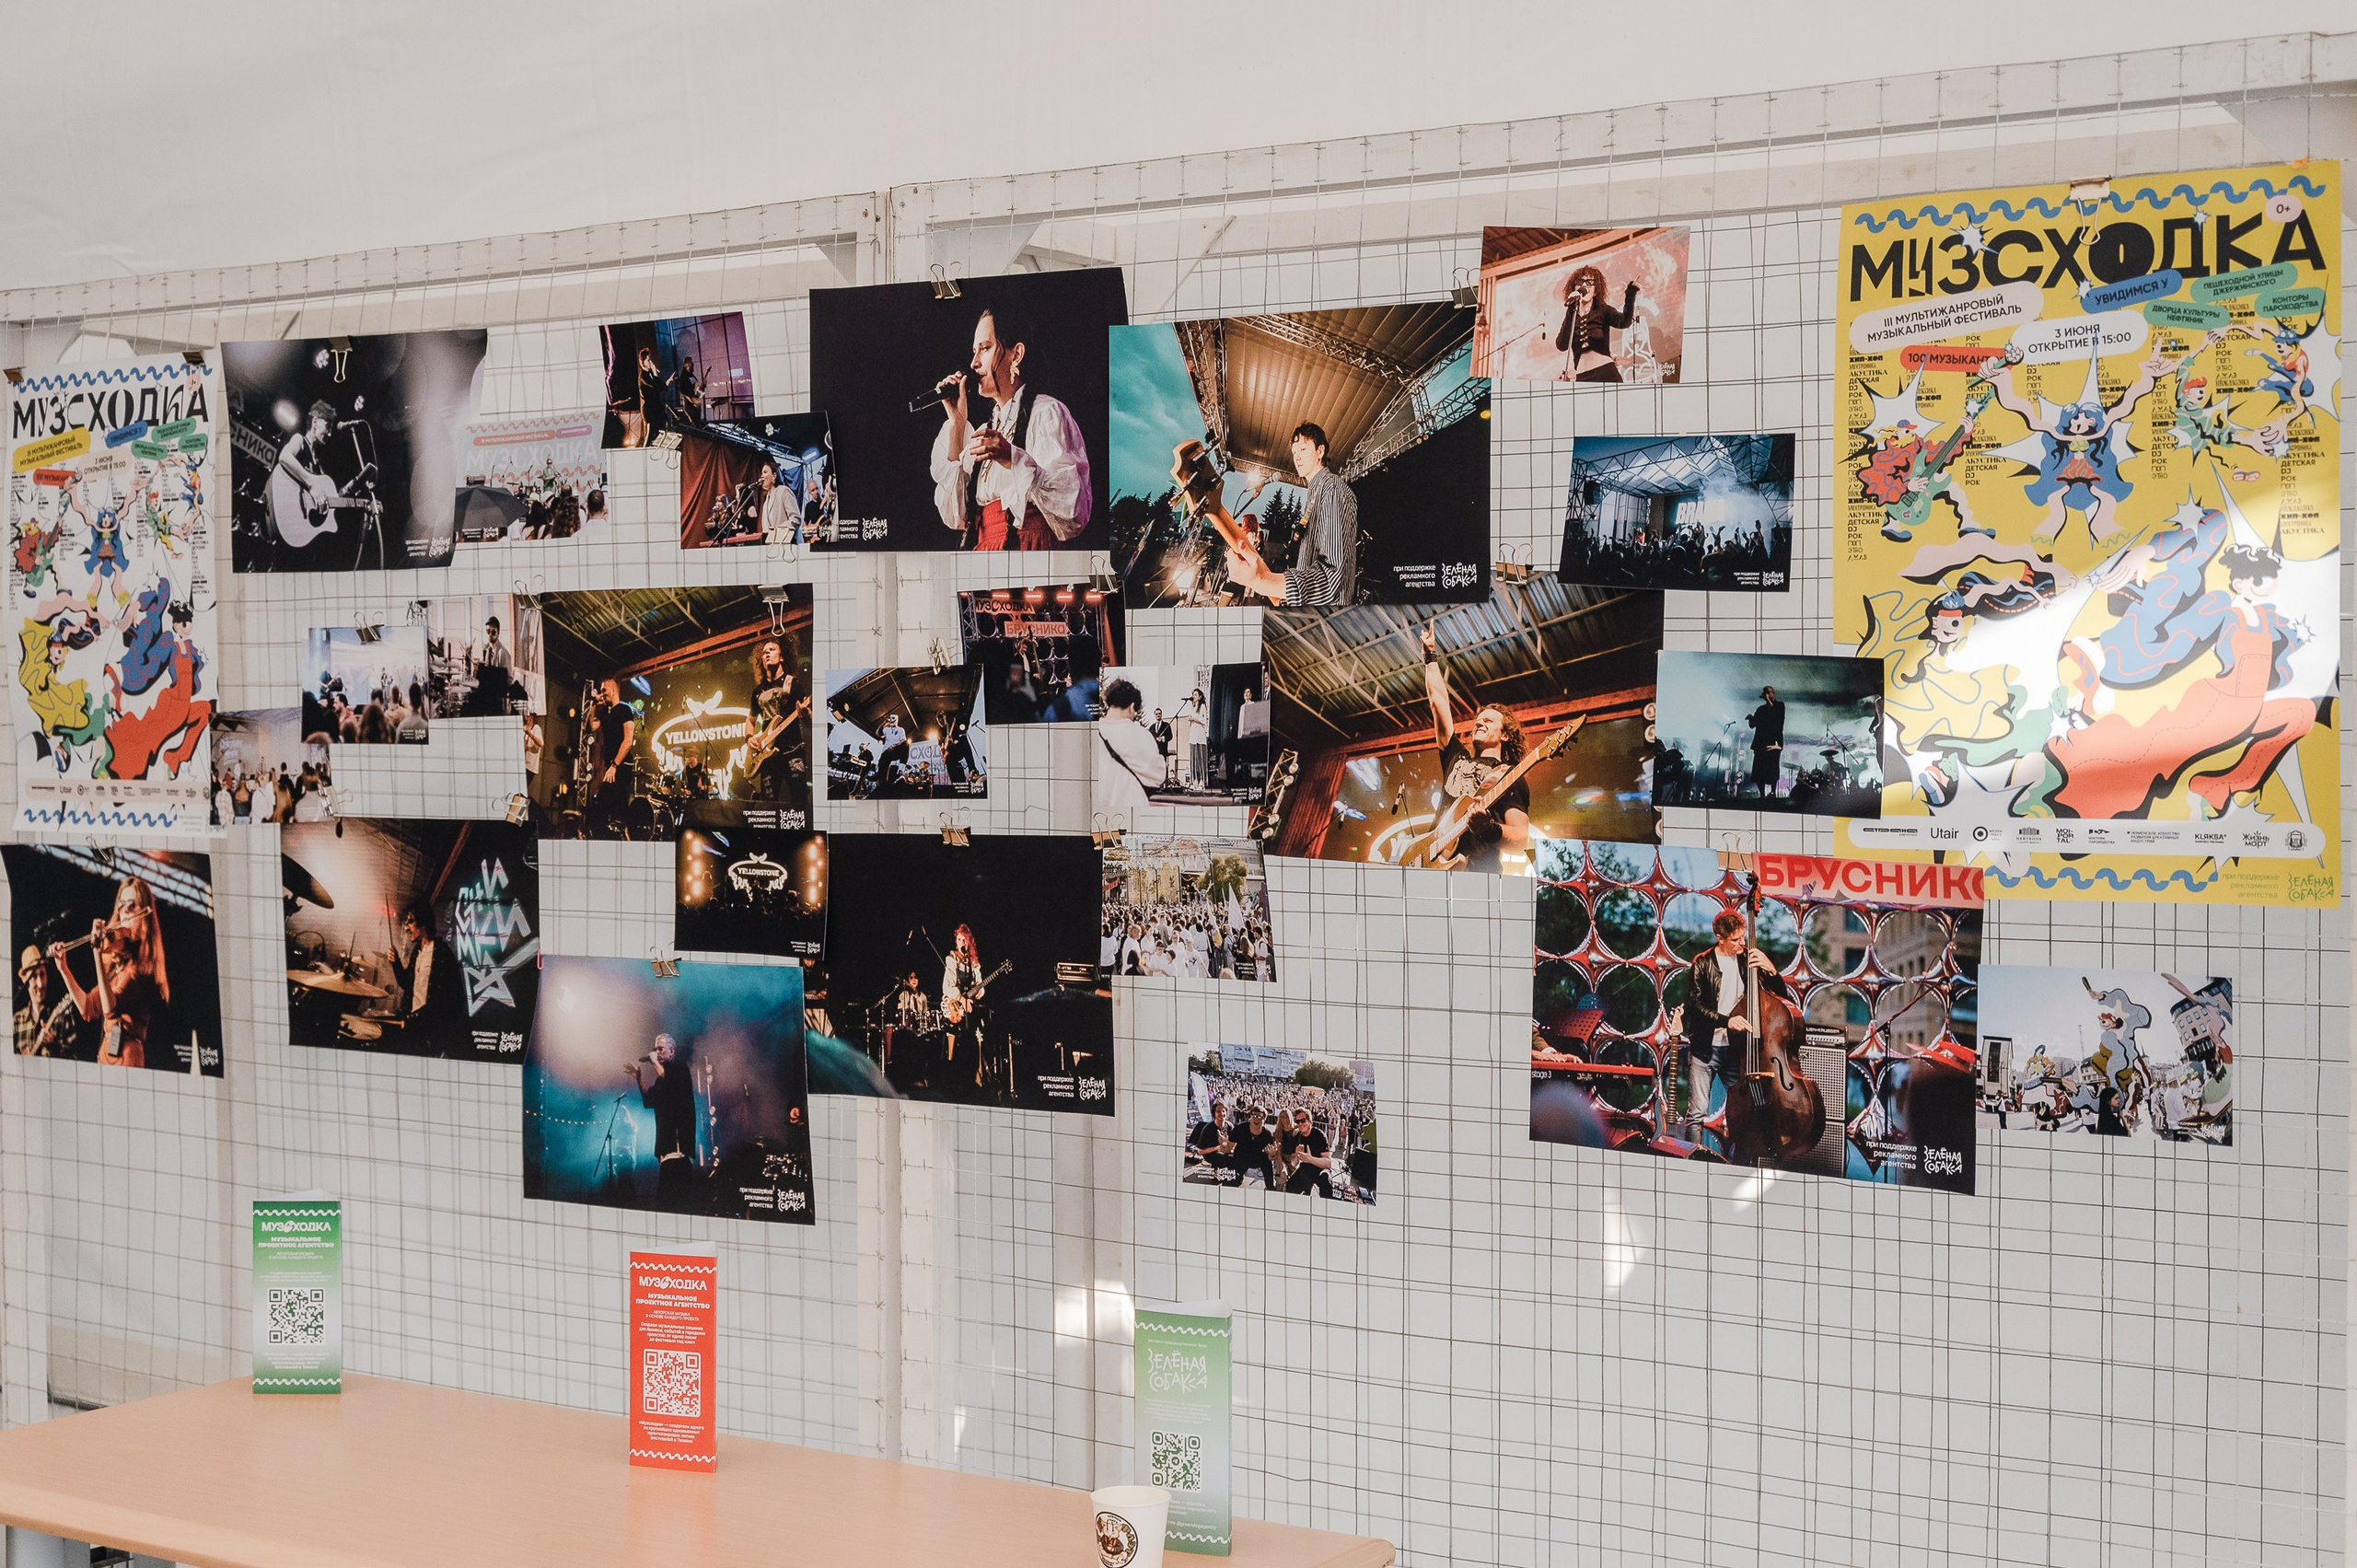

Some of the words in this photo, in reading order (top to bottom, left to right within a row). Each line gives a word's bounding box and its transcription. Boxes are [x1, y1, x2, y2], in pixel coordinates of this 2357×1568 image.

[2275, 203, 2292, 215] 0+
[2203, 272, 2256, 290] ПЕШЕХОДНОЙ
[2257, 269, 2284, 281] УЛИЦЫ
[2095, 281, 2158, 306] УВИДИМСЯ
[2160, 278, 2168, 288] У
[2272, 294, 2309, 304] КОНТОРЫ
[1896, 293, 2004, 325] МУЛЬТИЖАНРОВЫЙ
[2152, 305, 2182, 314] ДВОРЦА
[2183, 308, 2220, 319] КУЛЬТУРЫ
[2263, 301, 2318, 313] ПАРОХОДСТВА
[1867, 316, 1951, 343] МУЗЫКАЛЬНЫЙ
[1954, 304, 2022, 325] ФЕСТИВАЛЬ
[2166, 315, 2204, 324] НЕФТЯНИК
[2055, 329, 2061, 338] 3
[2064, 324, 2100, 337] ИЮНЯ
[2028, 337, 2089, 354] ОТКРЫТИЕ
[2102, 331, 2131, 345] 15:00
[13, 384, 209, 439] МУЗСХОДКА
[862, 517, 887, 532] ЗЕЛЁНАЯ
[1442, 562, 1477, 578] ЗЕЛЁНАЯ
[665, 723, 746, 745] YELLOWSTON
[1930, 828, 1958, 839] Utair
[737, 867, 780, 877] YELLOWSTONE
[1532, 1071, 1547, 1079] stage
[1548, 1071, 1552, 1079] 3
[1879, 1142, 1917, 1152] поддержке
[1873, 1150, 1917, 1160] рекламного
[1924, 1145, 1962, 1165] ЗЕЛЁНАЯ
[1881, 1160, 1916, 1169] агентства
[636, 1298, 673, 1307] ПРОЕКТНОЕ
[648, 1293, 697, 1302] МУЗЫКАЛЬНОЕ
[1148, 1348, 1207, 1376] ЗЕЛЁНАЯ
